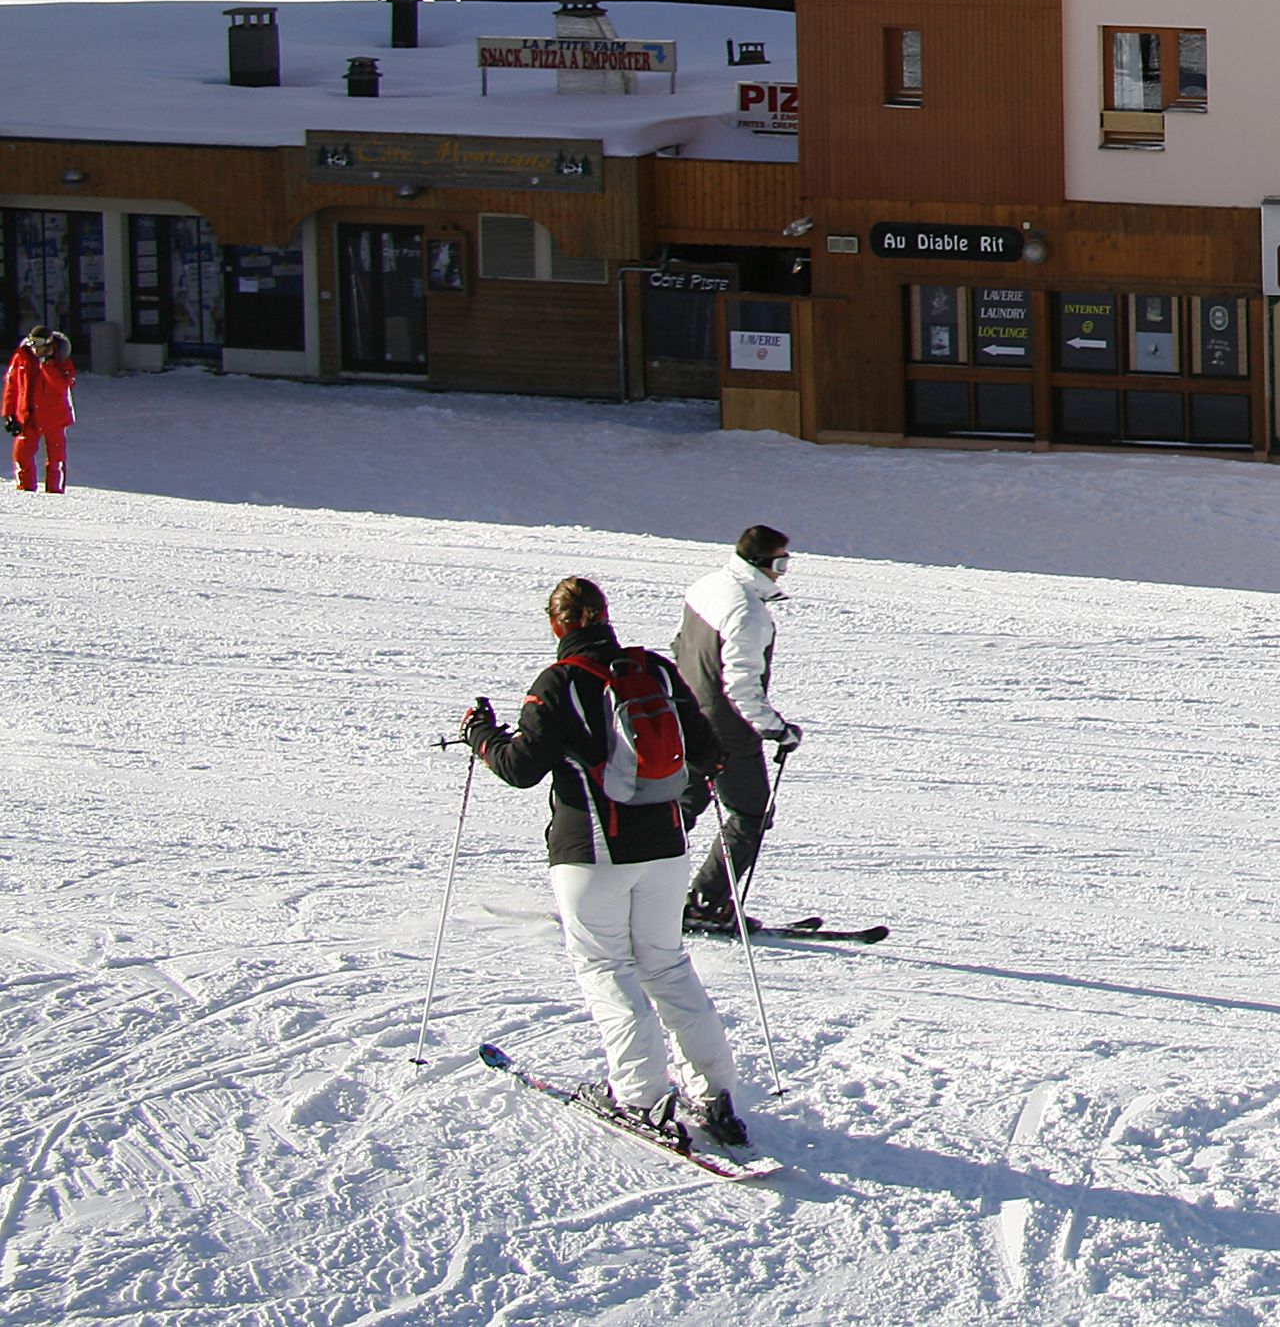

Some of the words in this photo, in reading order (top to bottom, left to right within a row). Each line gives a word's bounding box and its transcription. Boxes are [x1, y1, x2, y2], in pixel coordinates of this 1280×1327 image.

[522, 39, 540, 49] LA
[594, 41, 627, 52] FAIM
[481, 47, 522, 67] SNACK
[531, 49, 567, 69] PIZZA
[583, 51, 651, 70] EMPORTER
[420, 140, 550, 169] Montagne
[884, 233, 905, 249] Au
[917, 234, 968, 251] Diable
[980, 236, 1004, 253] Rit
[983, 289, 1025, 302] LAVERIE
[980, 307, 1027, 319] LAUNDRY
[1064, 304, 1112, 315] INTERNET
[978, 325, 1029, 338] LOC'LINGE
[740, 334, 781, 347] LAVERIE
